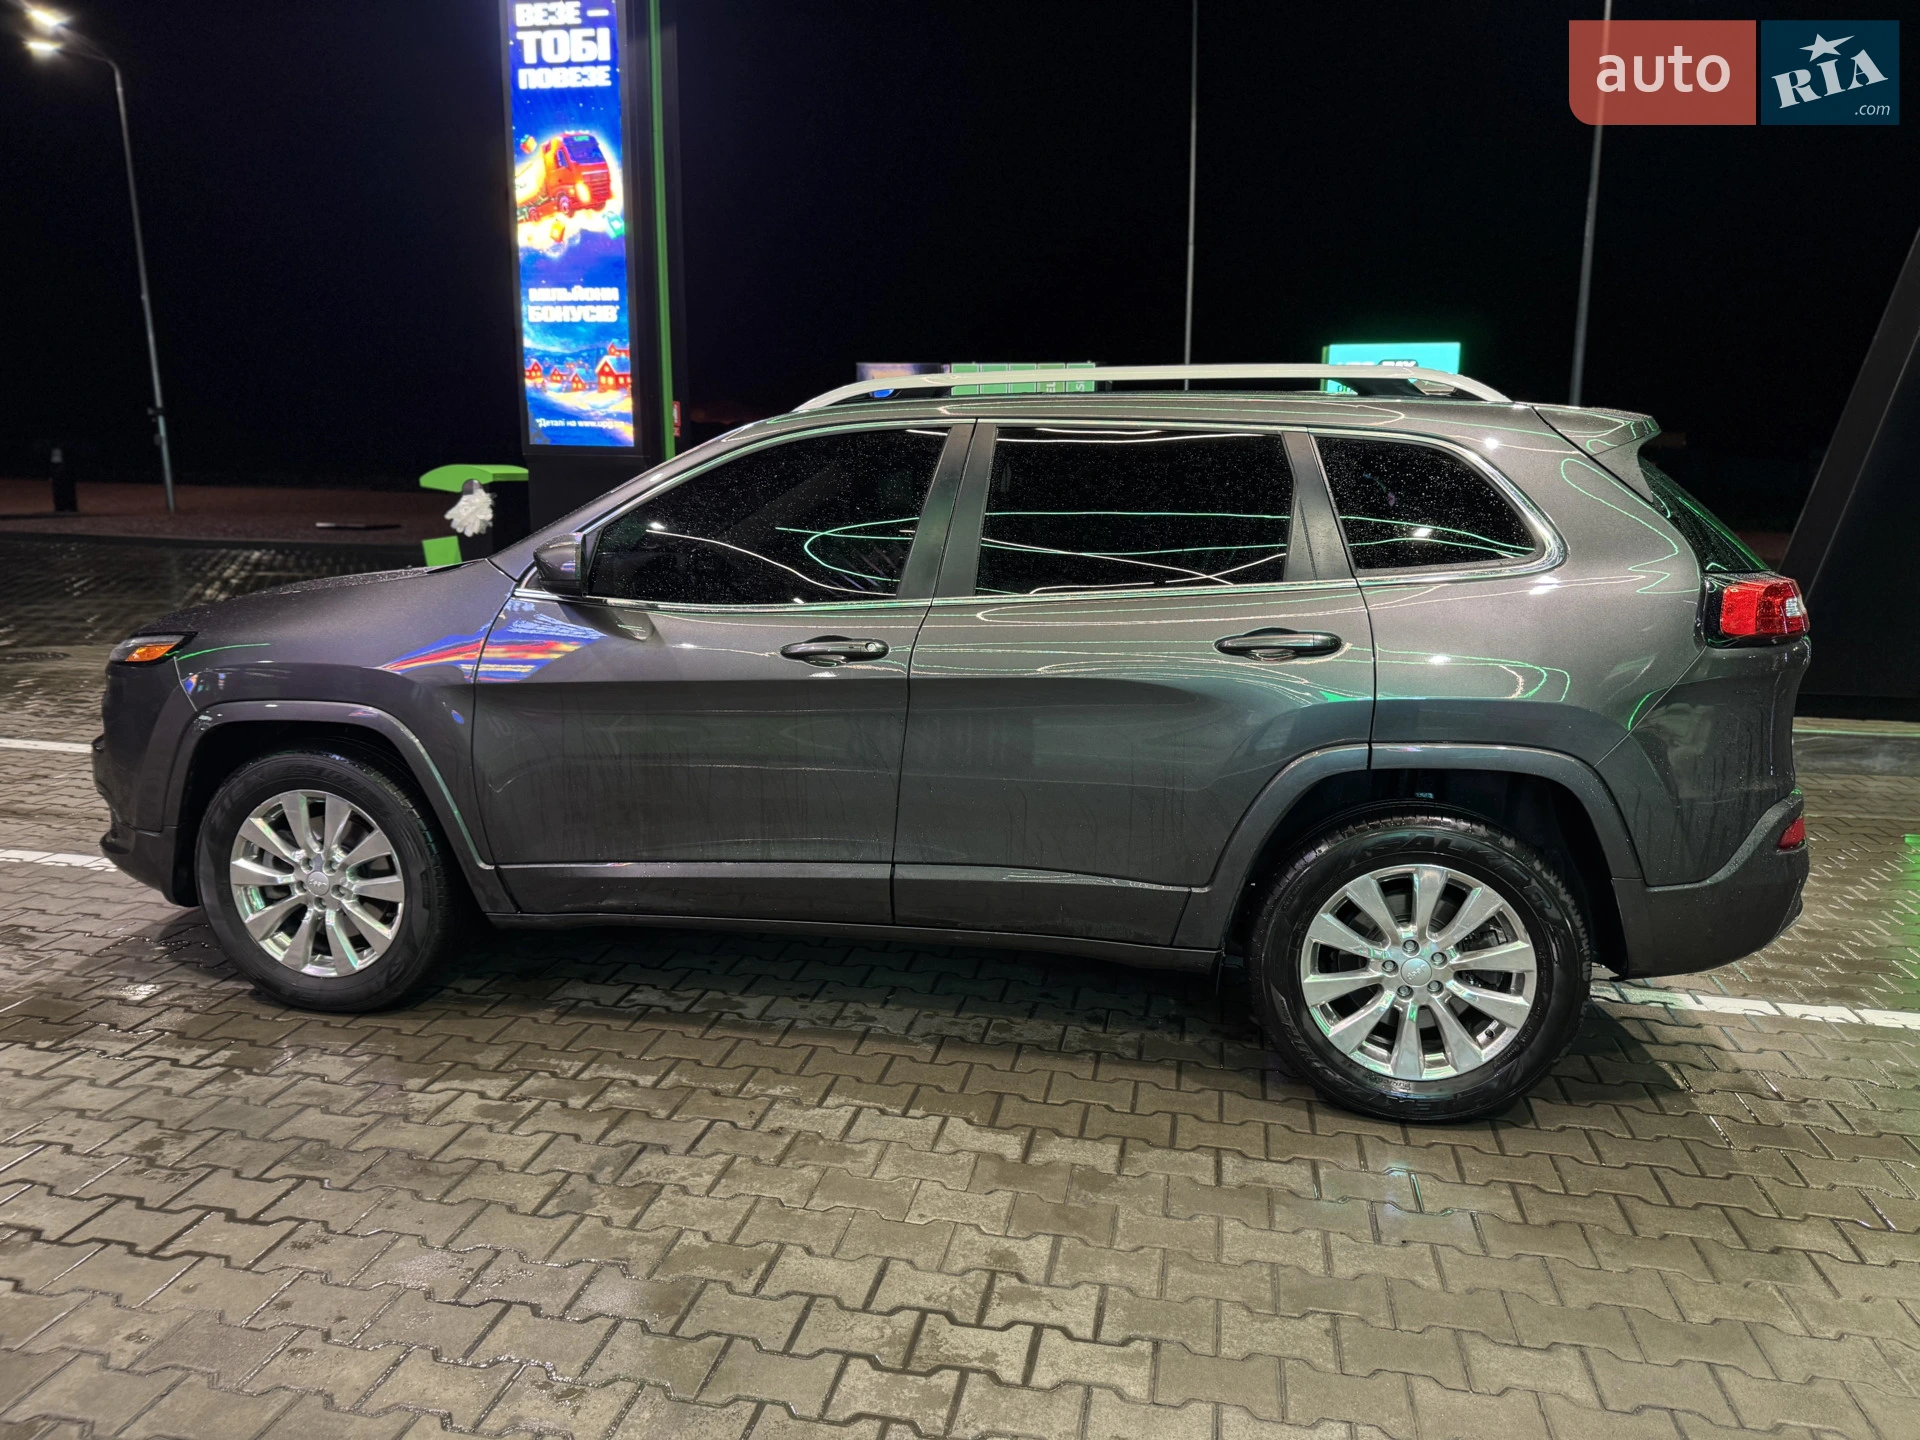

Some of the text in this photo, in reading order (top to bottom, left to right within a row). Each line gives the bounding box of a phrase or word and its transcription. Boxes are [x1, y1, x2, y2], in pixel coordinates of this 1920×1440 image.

[515, 1, 582, 27] ВЕЗЕ
[516, 27, 611, 64] ТОБІ
[518, 65, 612, 90] ПОВЕЗЕ
